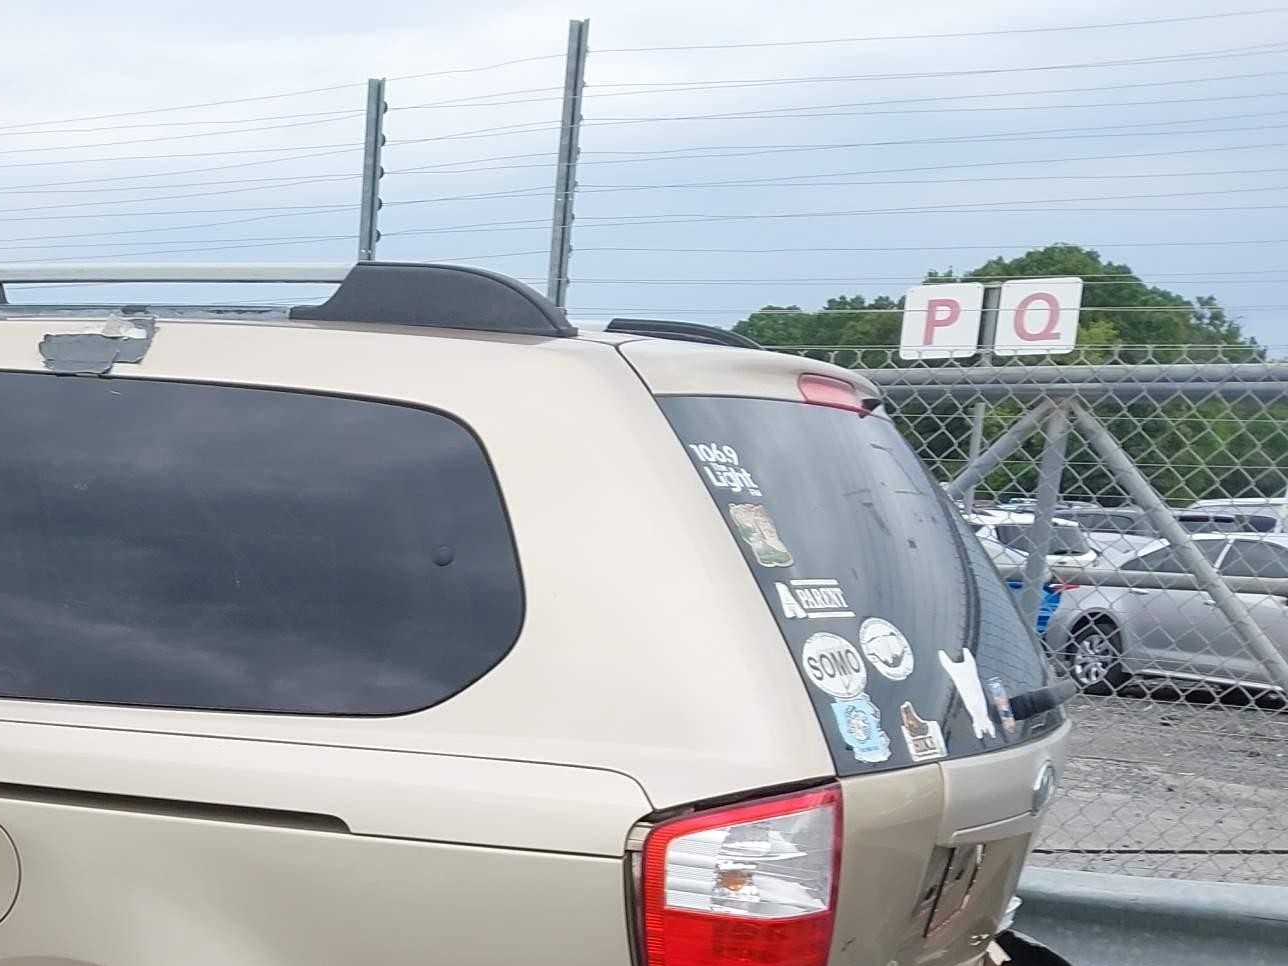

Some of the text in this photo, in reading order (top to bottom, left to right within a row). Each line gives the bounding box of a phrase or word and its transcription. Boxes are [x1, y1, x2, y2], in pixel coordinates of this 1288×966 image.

[923, 298, 961, 346] P
[1014, 292, 1061, 342] Q
[807, 648, 861, 681] SOMO
